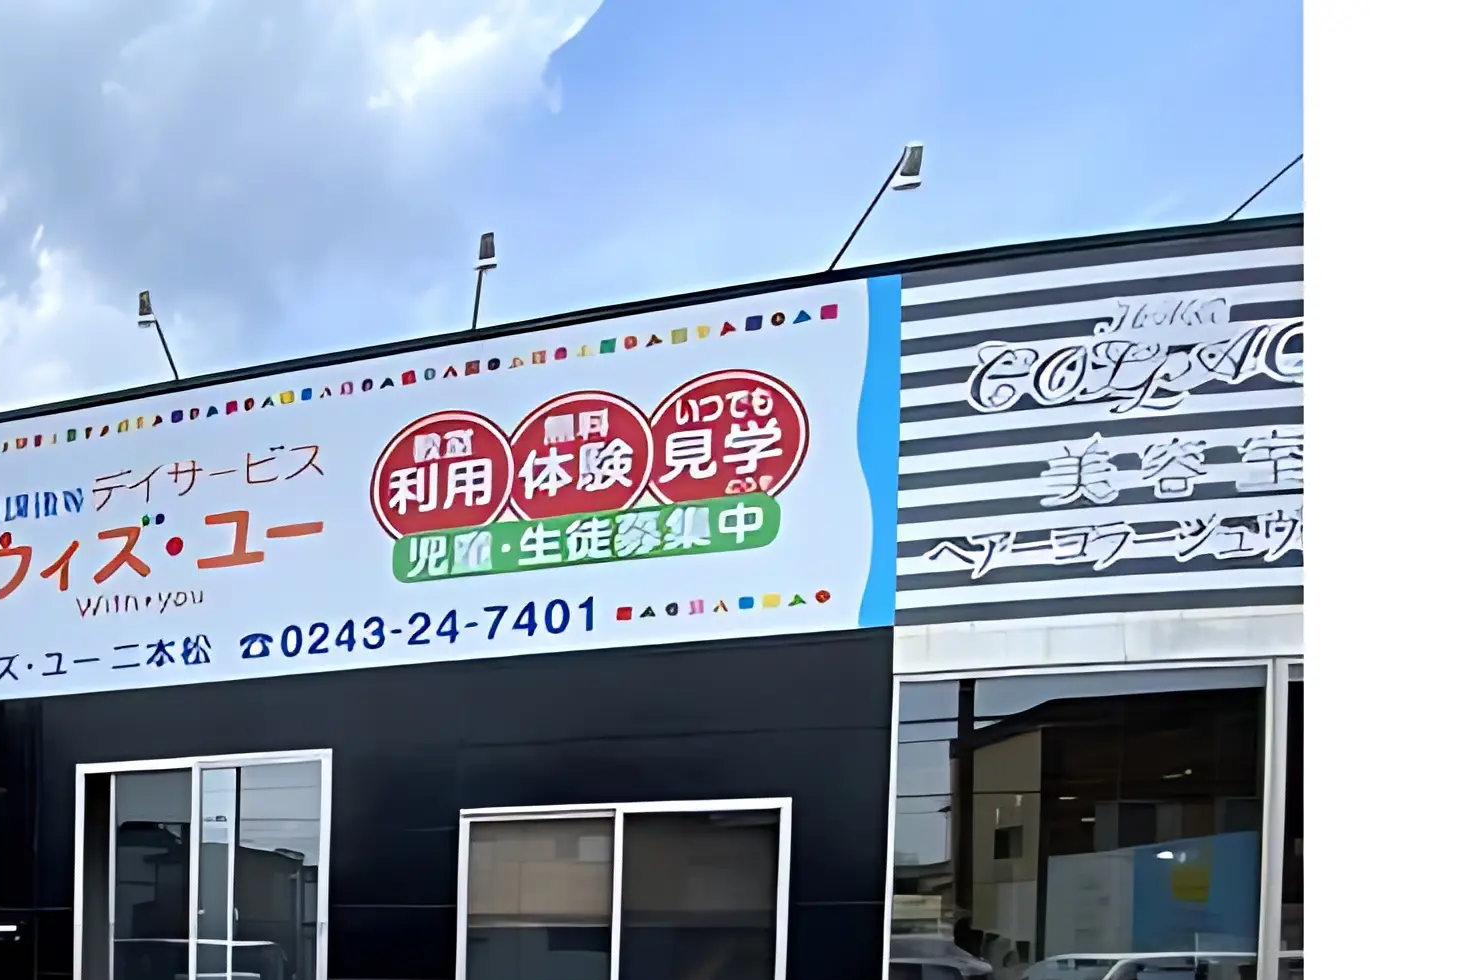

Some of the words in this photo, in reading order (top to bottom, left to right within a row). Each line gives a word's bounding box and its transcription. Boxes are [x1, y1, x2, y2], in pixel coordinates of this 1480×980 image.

[675, 387, 774, 424] いつでも
[517, 436, 634, 500] 体験
[658, 416, 784, 484] 見学
[1040, 430, 1304, 504] 美容室
[388, 457, 493, 515] 利用
[280, 595, 595, 658] 0243-24-7401
